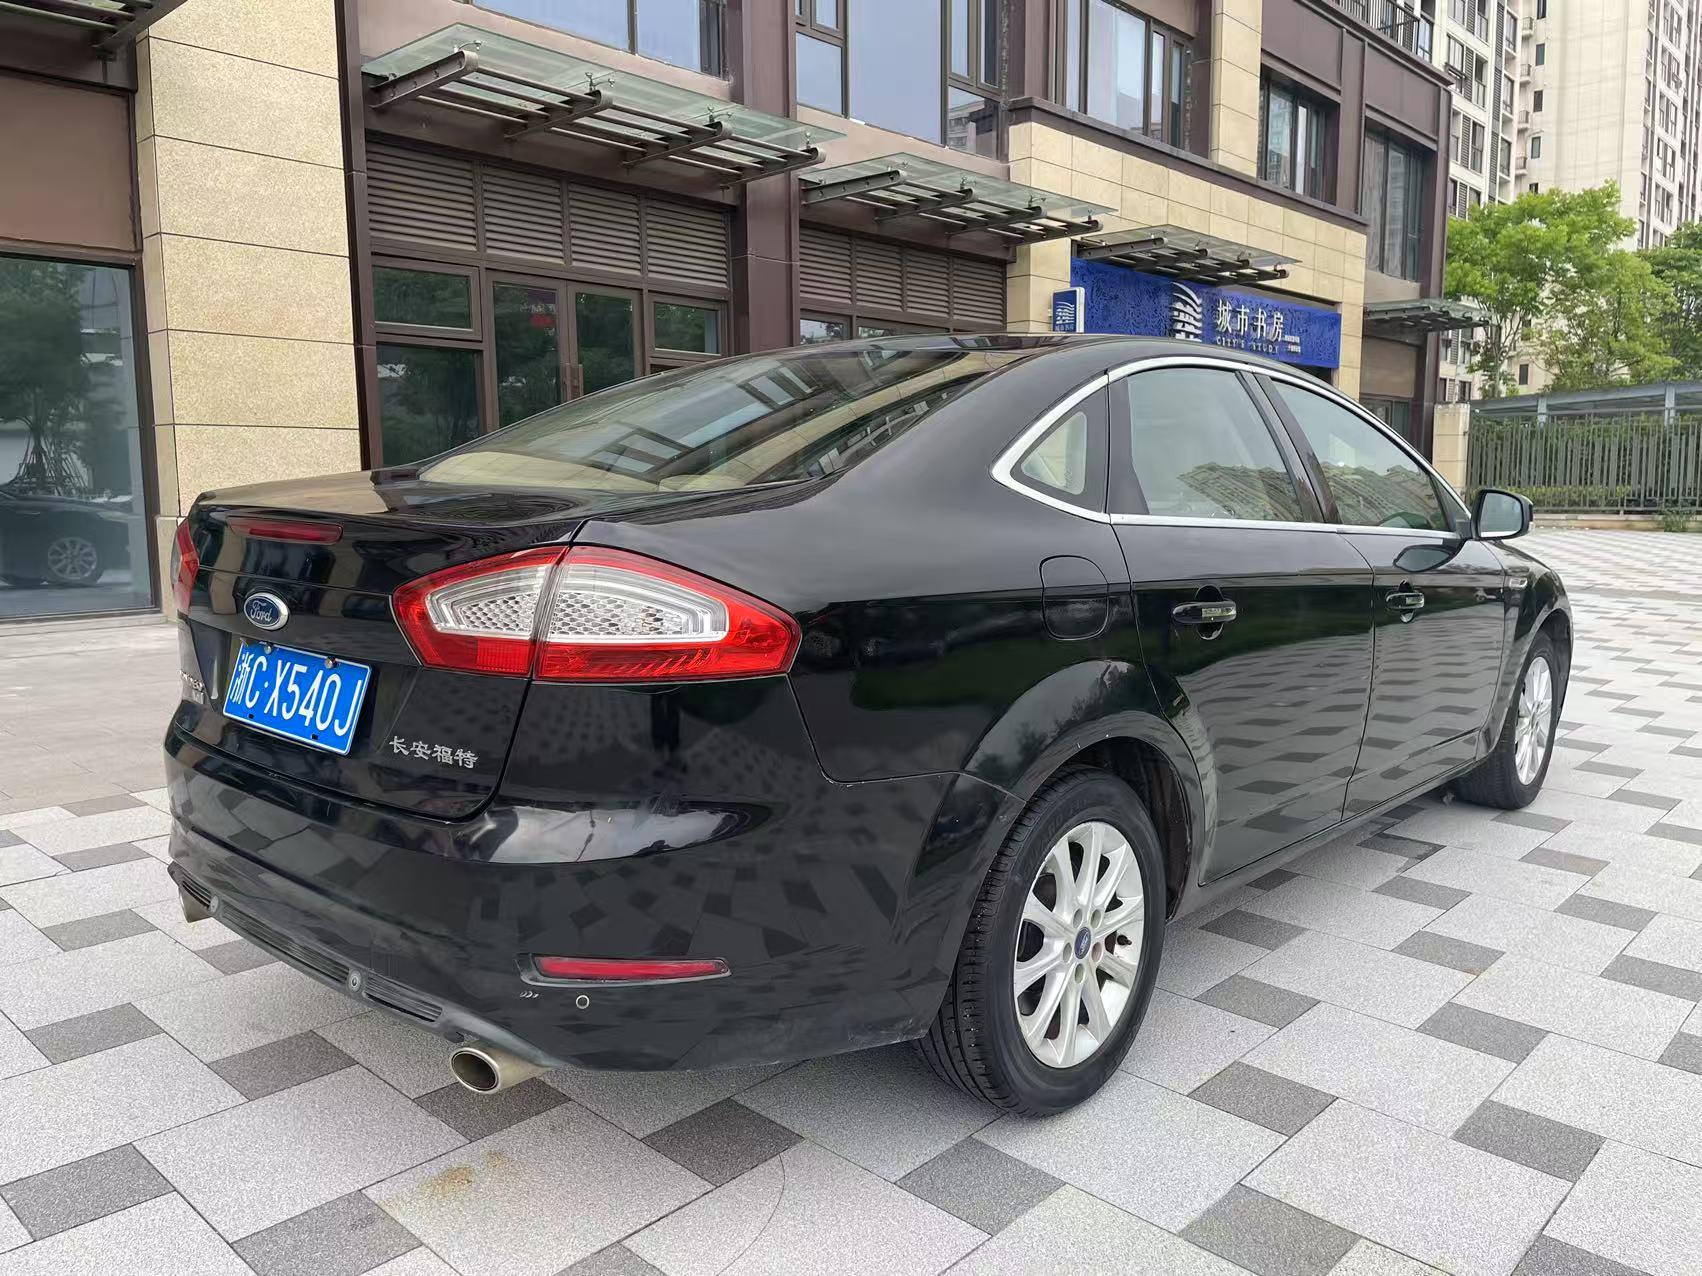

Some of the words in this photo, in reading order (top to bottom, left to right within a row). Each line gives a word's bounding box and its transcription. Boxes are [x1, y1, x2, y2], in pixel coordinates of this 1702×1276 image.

[1217, 299, 1284, 342] 城市书房
[1252, 342, 1279, 354] STUDY
[250, 600, 273, 622] Ford
[388, 735, 479, 769] 长安福特
